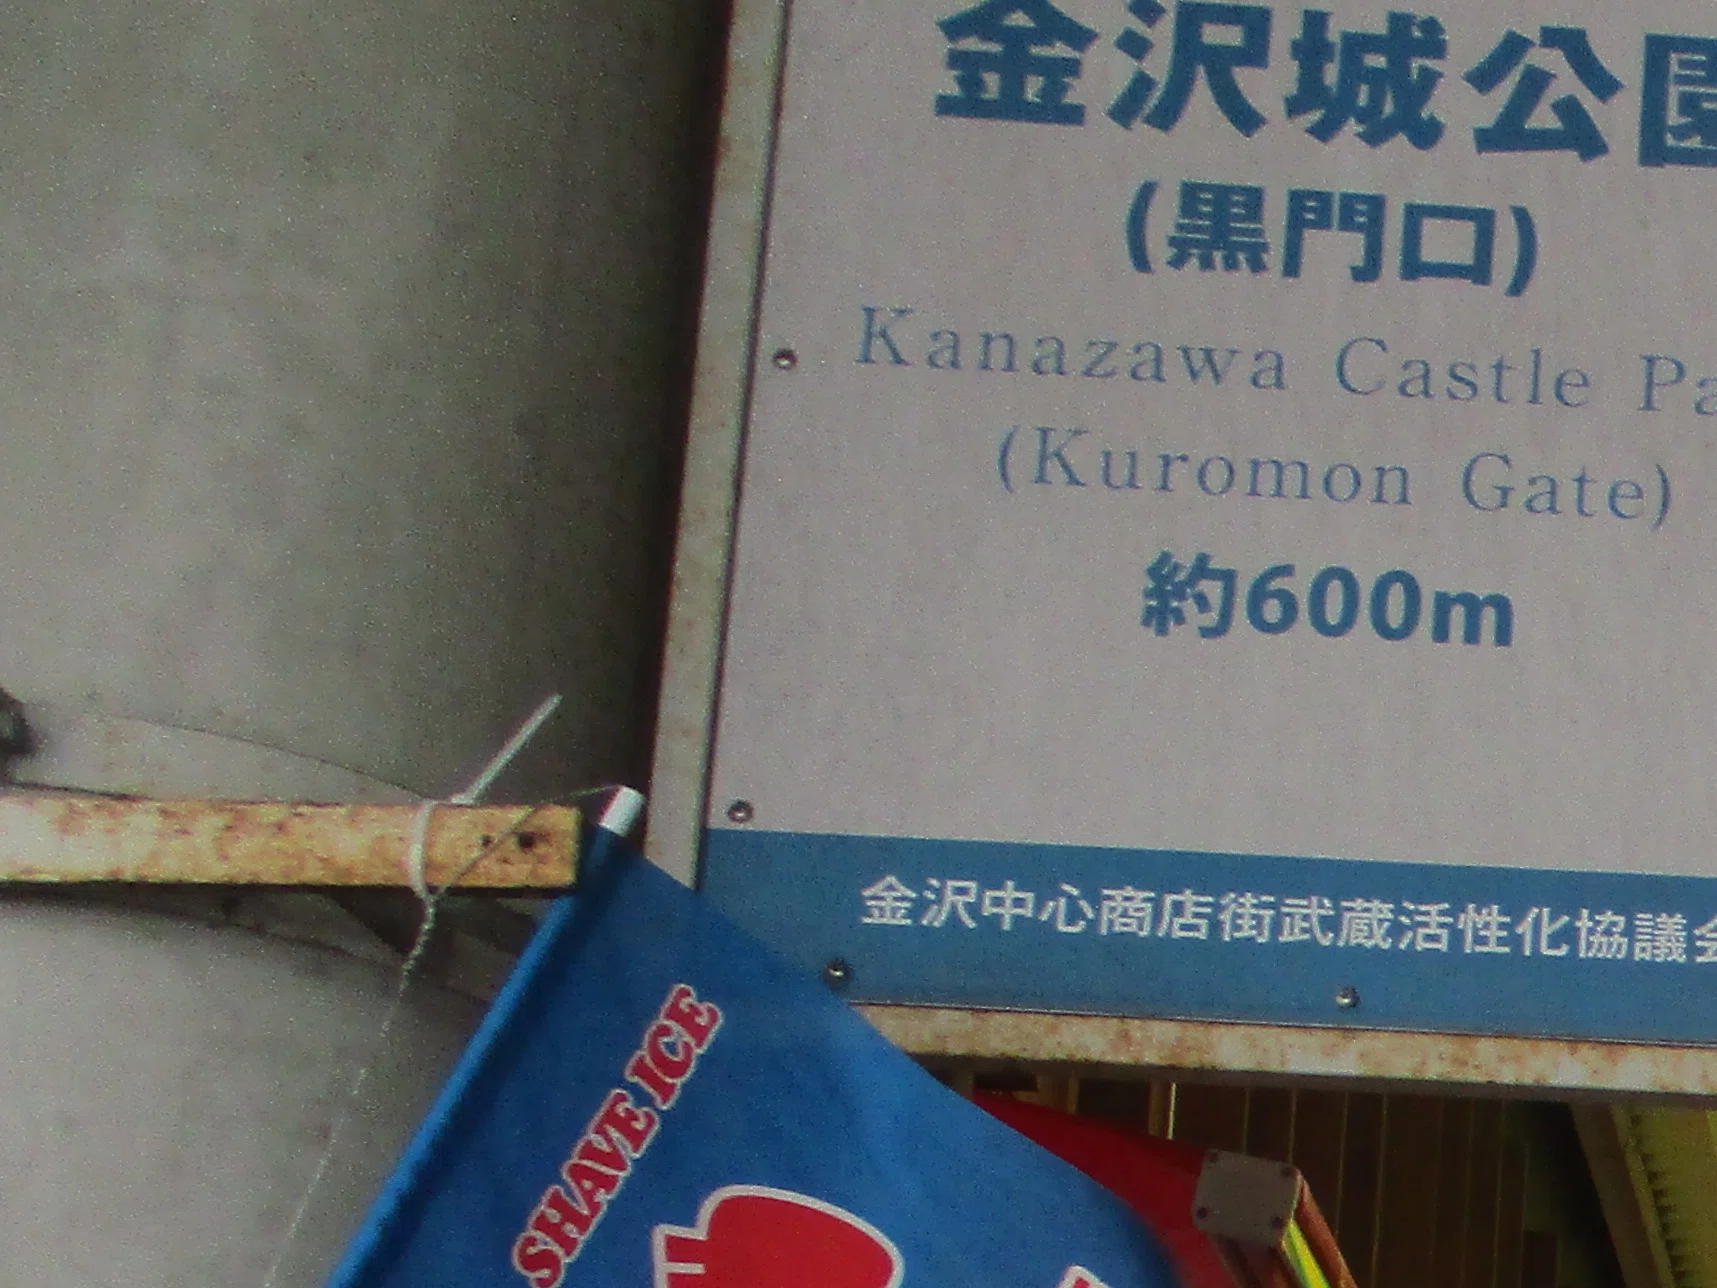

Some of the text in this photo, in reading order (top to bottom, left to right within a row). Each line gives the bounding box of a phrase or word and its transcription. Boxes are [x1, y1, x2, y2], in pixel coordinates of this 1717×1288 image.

[1125, 181, 1540, 297] (黒門口)
[854, 306, 1289, 393] Kanazawa
[1335, 337, 1592, 410] Castle
[998, 424, 1675, 528] (Kuromon Gate)
[1141, 552, 1516, 647] 約600m
[629, 983, 724, 1110] ICE
